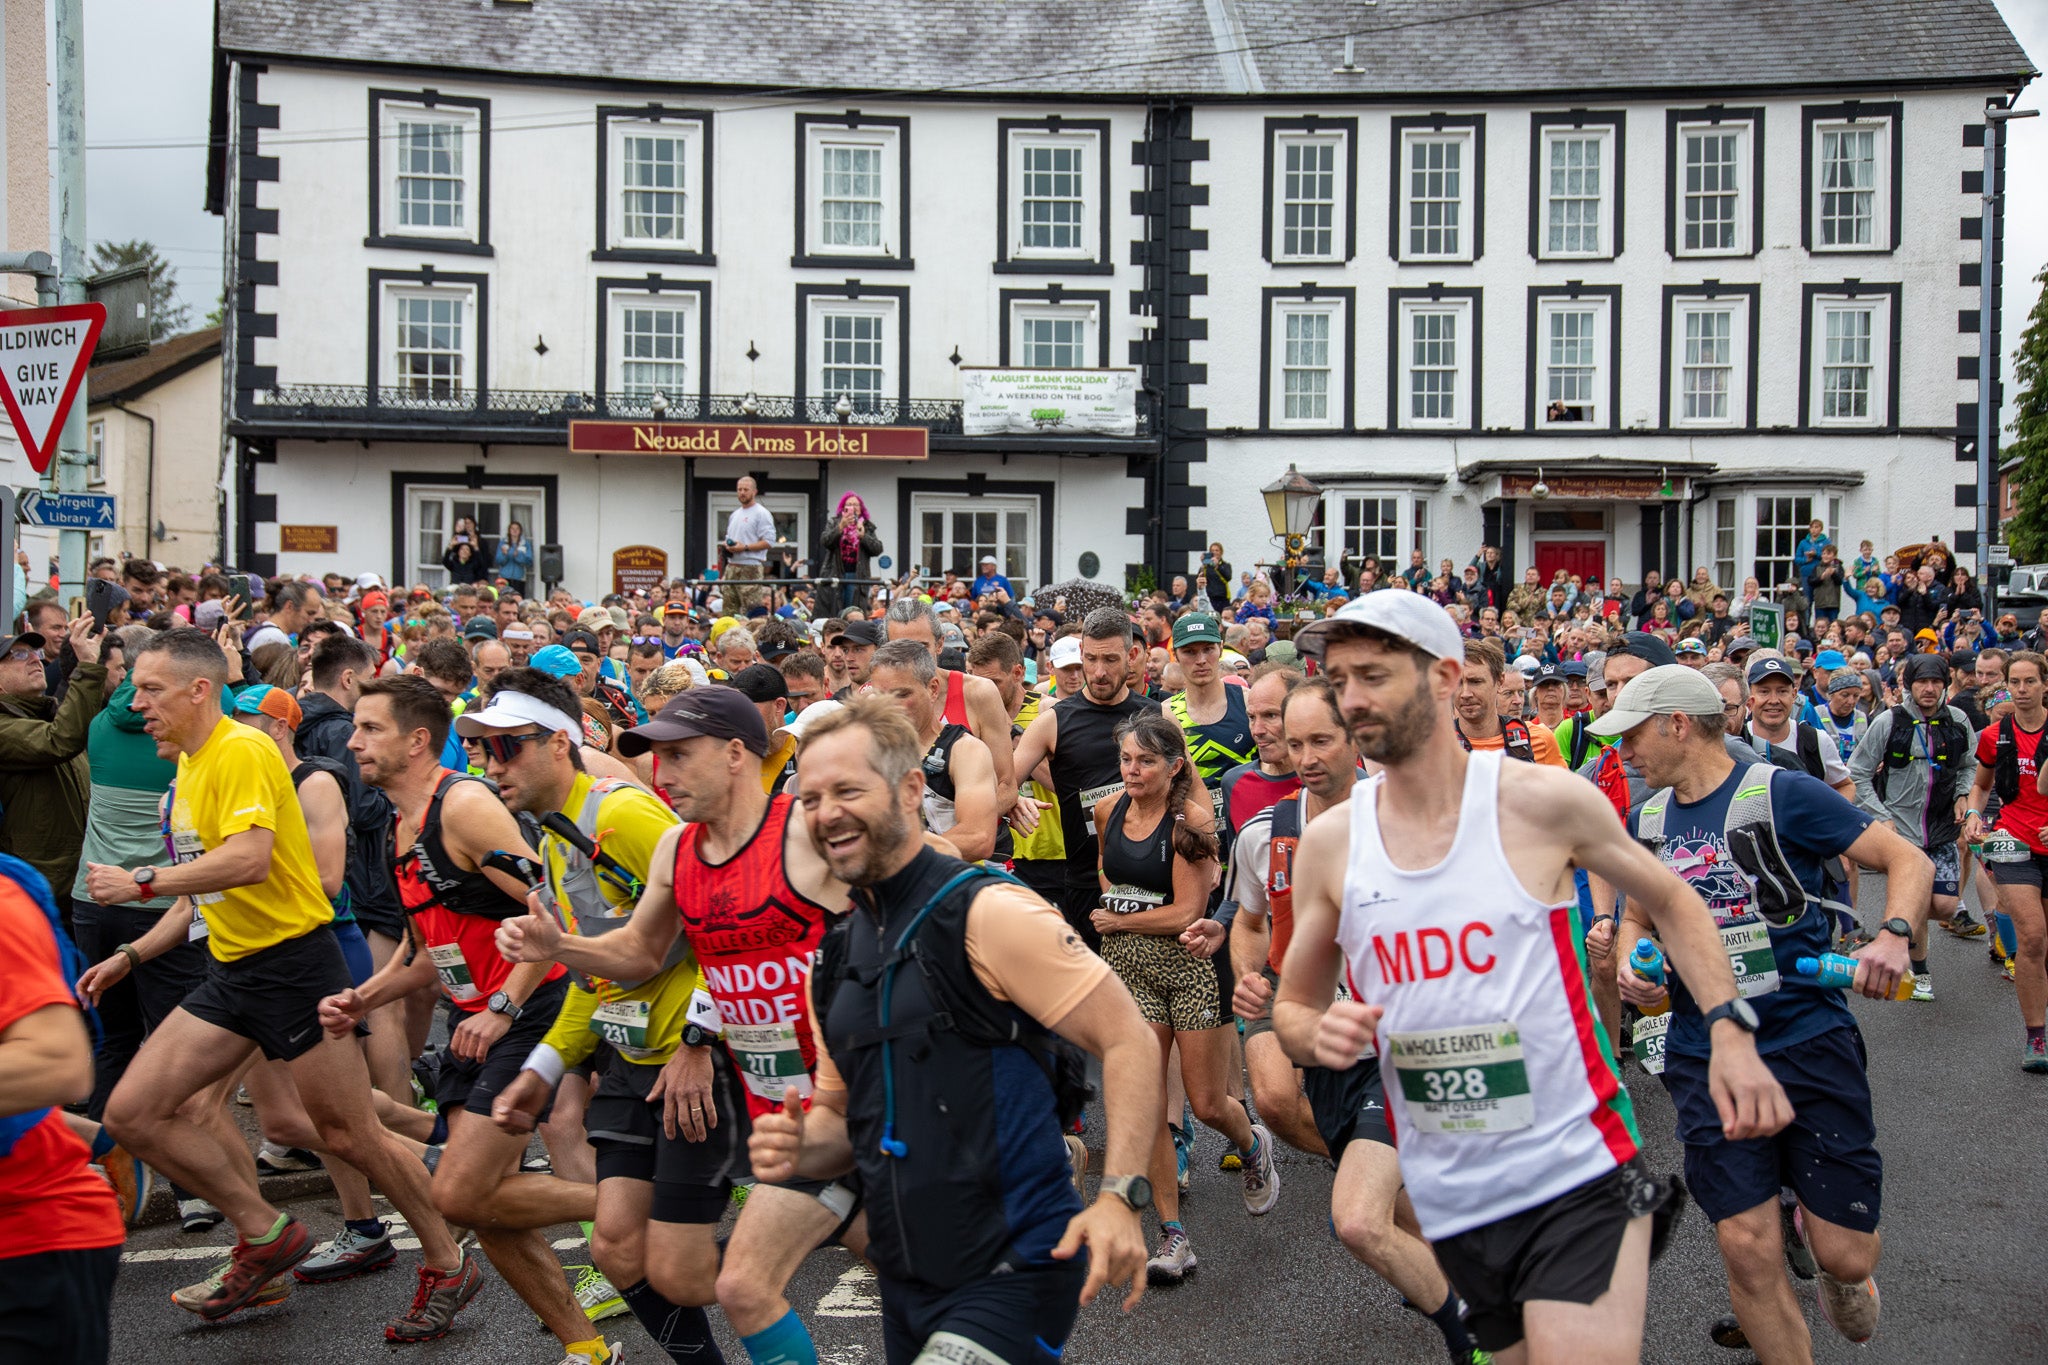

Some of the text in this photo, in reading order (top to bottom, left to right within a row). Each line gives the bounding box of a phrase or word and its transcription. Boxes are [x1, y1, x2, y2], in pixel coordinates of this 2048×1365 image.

[0, 327, 76, 350] ILDIWCH
[17, 363, 58, 382] GIVE
[991, 375, 1031, 383] AUGUST
[1065, 376, 1109, 384] HOLIDAY
[19, 387, 58, 406] WAY
[632, 427, 868, 453] Neuadd Arms Hotel
[49, 511, 92, 527] Library
[1992, 841, 2016, 852] 228
[1105, 897, 1140, 914] 1142
[1372, 921, 1497, 985] MDC
[703, 951, 815, 994] NDON
[1736, 973, 1765, 985] ARSON
[602, 1023, 631, 1046] 231
[1402, 1038, 1449, 1056] WHOLE
[745, 1053, 777, 1076] 277
[1423, 1067, 1489, 1102] 328
[1453, 1099, 1500, 1112] O'KEEFE
